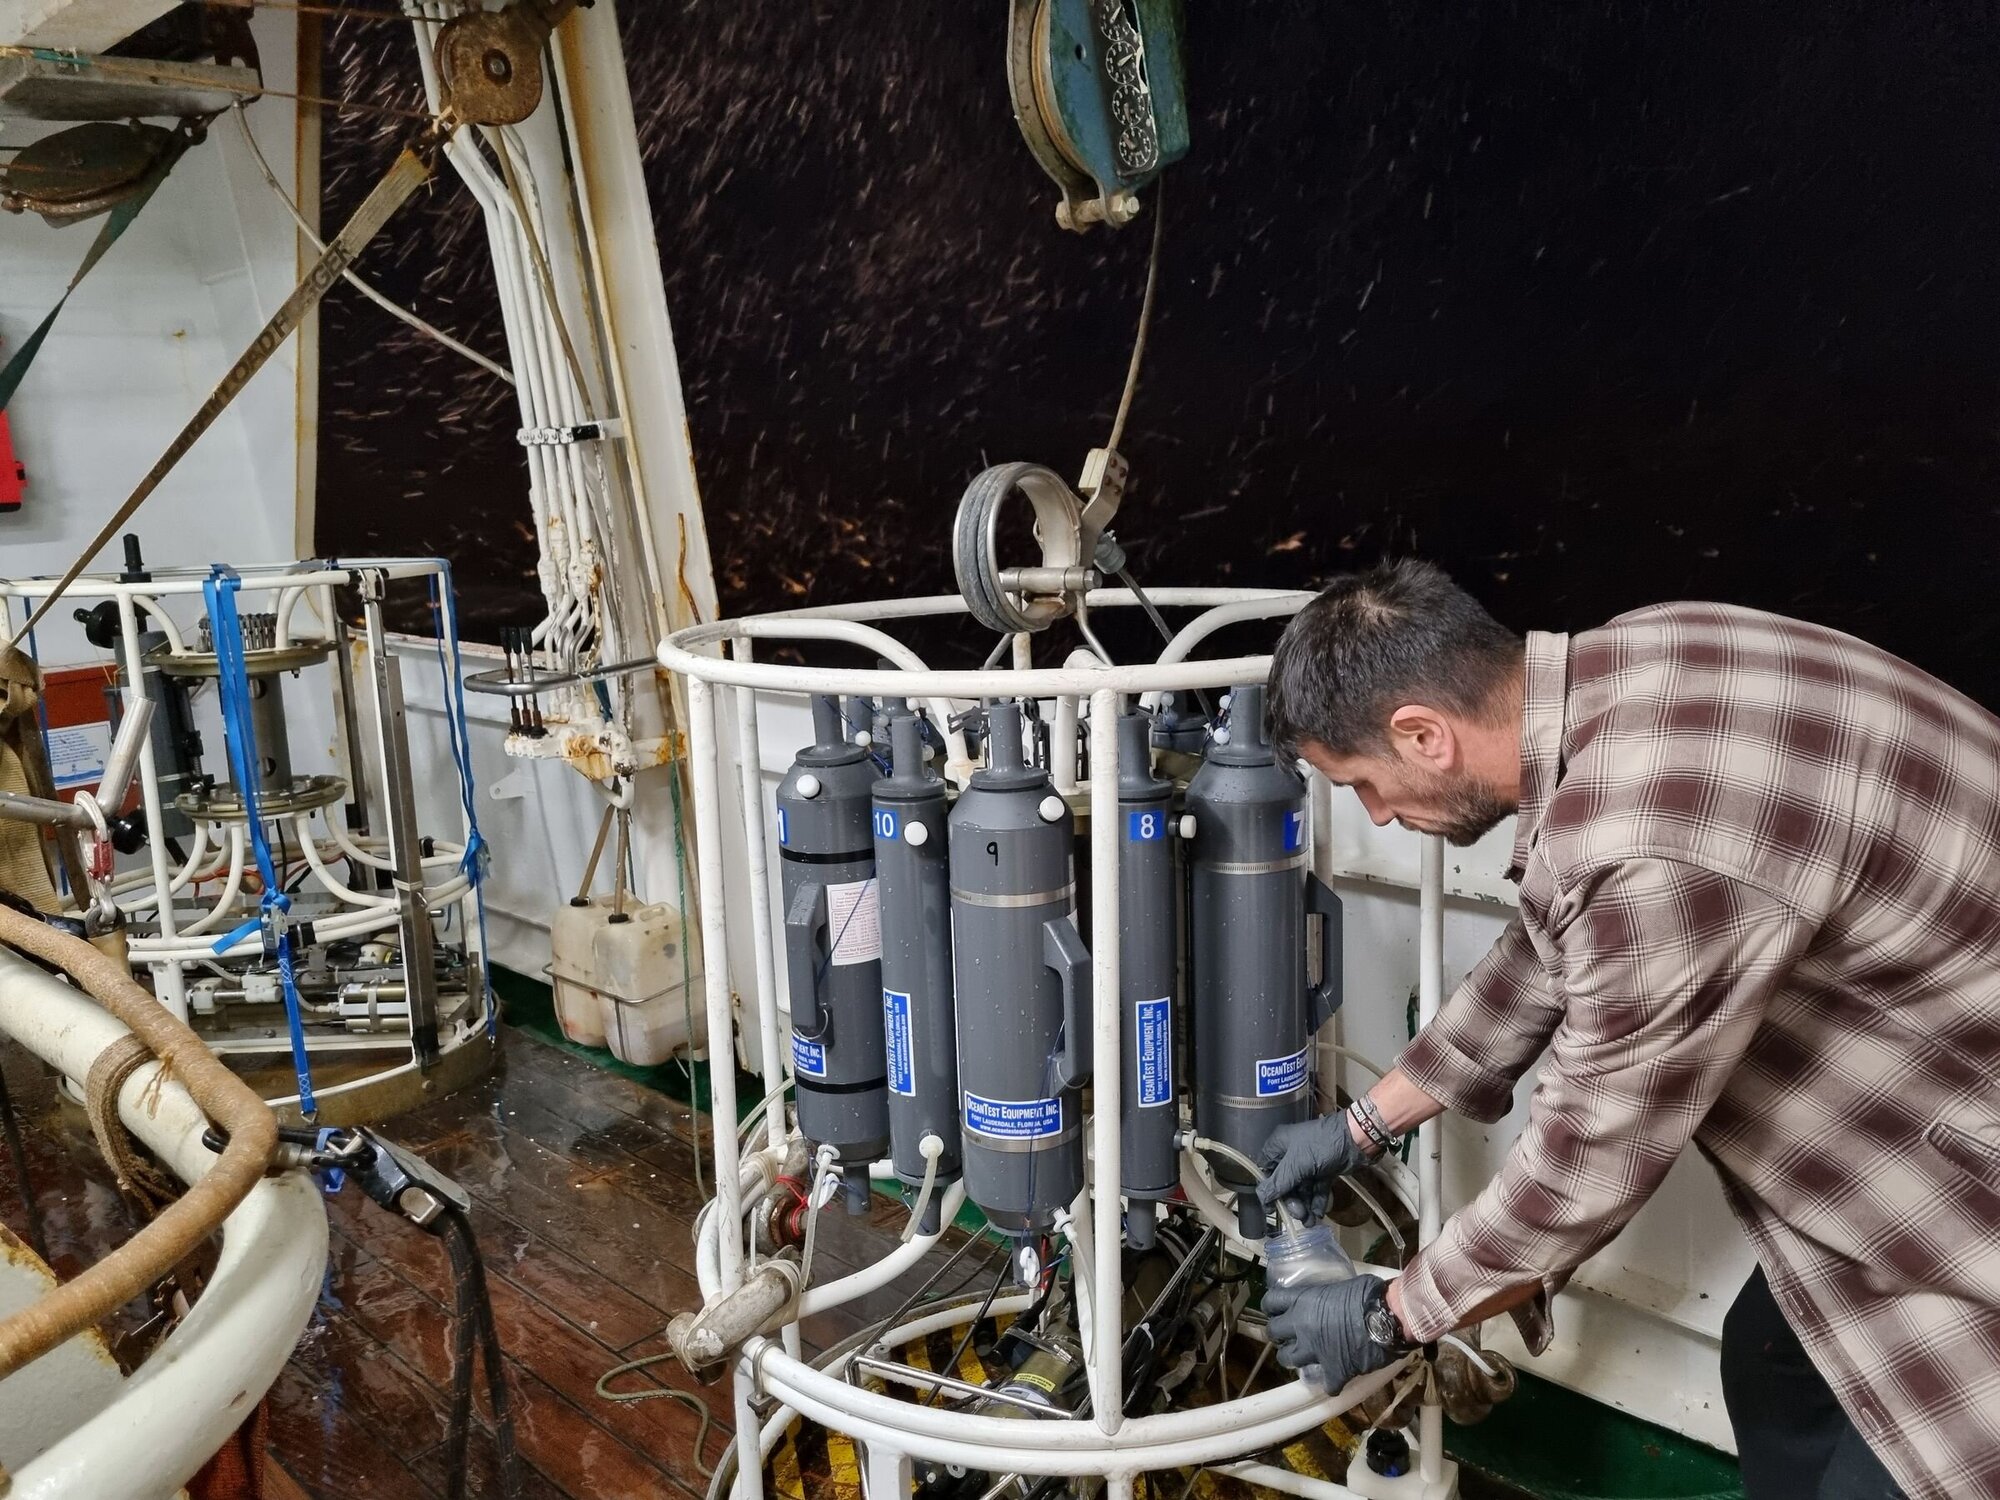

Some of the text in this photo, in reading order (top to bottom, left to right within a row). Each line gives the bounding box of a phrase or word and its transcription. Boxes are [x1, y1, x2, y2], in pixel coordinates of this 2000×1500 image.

[874, 811, 895, 838] 10
[1140, 813, 1155, 839] 8
[1292, 810, 1305, 846] 7
[986, 841, 999, 867] 9
[1141, 1004, 1156, 1103] OCEANTEST EQUIPMENT, INC.
[889, 1050, 898, 1088] OCEANTEST
[1261, 1062, 1297, 1078] OCEANTEST
[967, 1096, 1000, 1118] OCEANTEST
[1045, 1103, 1059, 1116] INC.
[1042, 1118, 1053, 1126] USA
